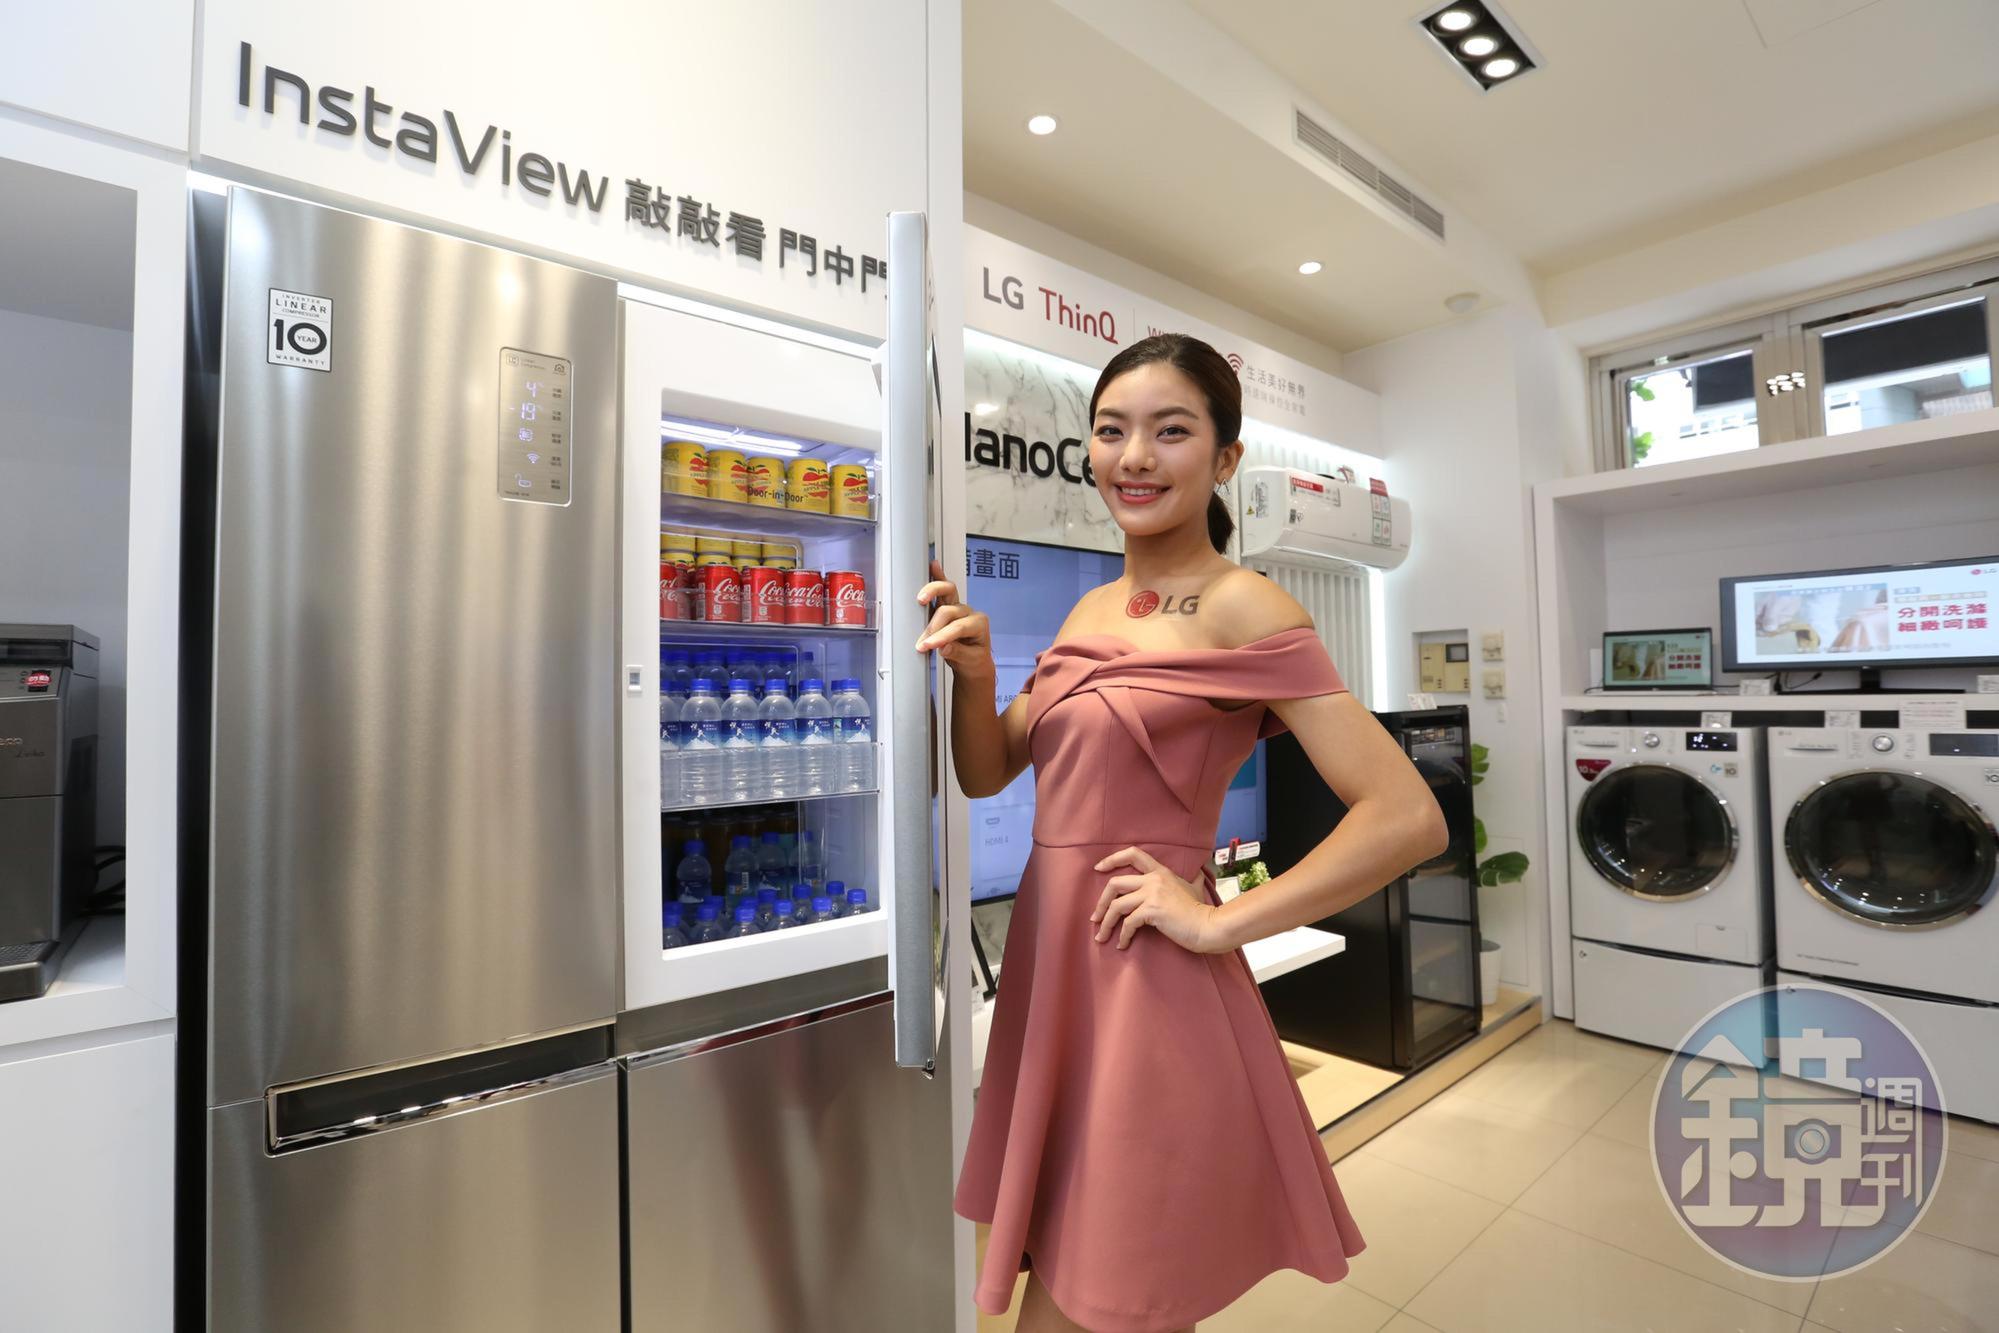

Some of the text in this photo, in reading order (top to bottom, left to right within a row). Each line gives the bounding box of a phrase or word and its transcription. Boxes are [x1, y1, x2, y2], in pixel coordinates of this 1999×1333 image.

[238, 41, 609, 212] InstaView
[624, 177, 767, 262] 敲敲看
[275, 298, 328, 314] LINEAR
[983, 266, 1119, 345] LG ThinQ
[273, 318, 328, 355] 10
[297, 335, 317, 343] YEAR
[275, 354, 326, 366] WARRANTY
[747, 486, 803, 502] Door-in-Door
[966, 549, 1020, 580] 畫面
[1161, 594, 1200, 615] LG
